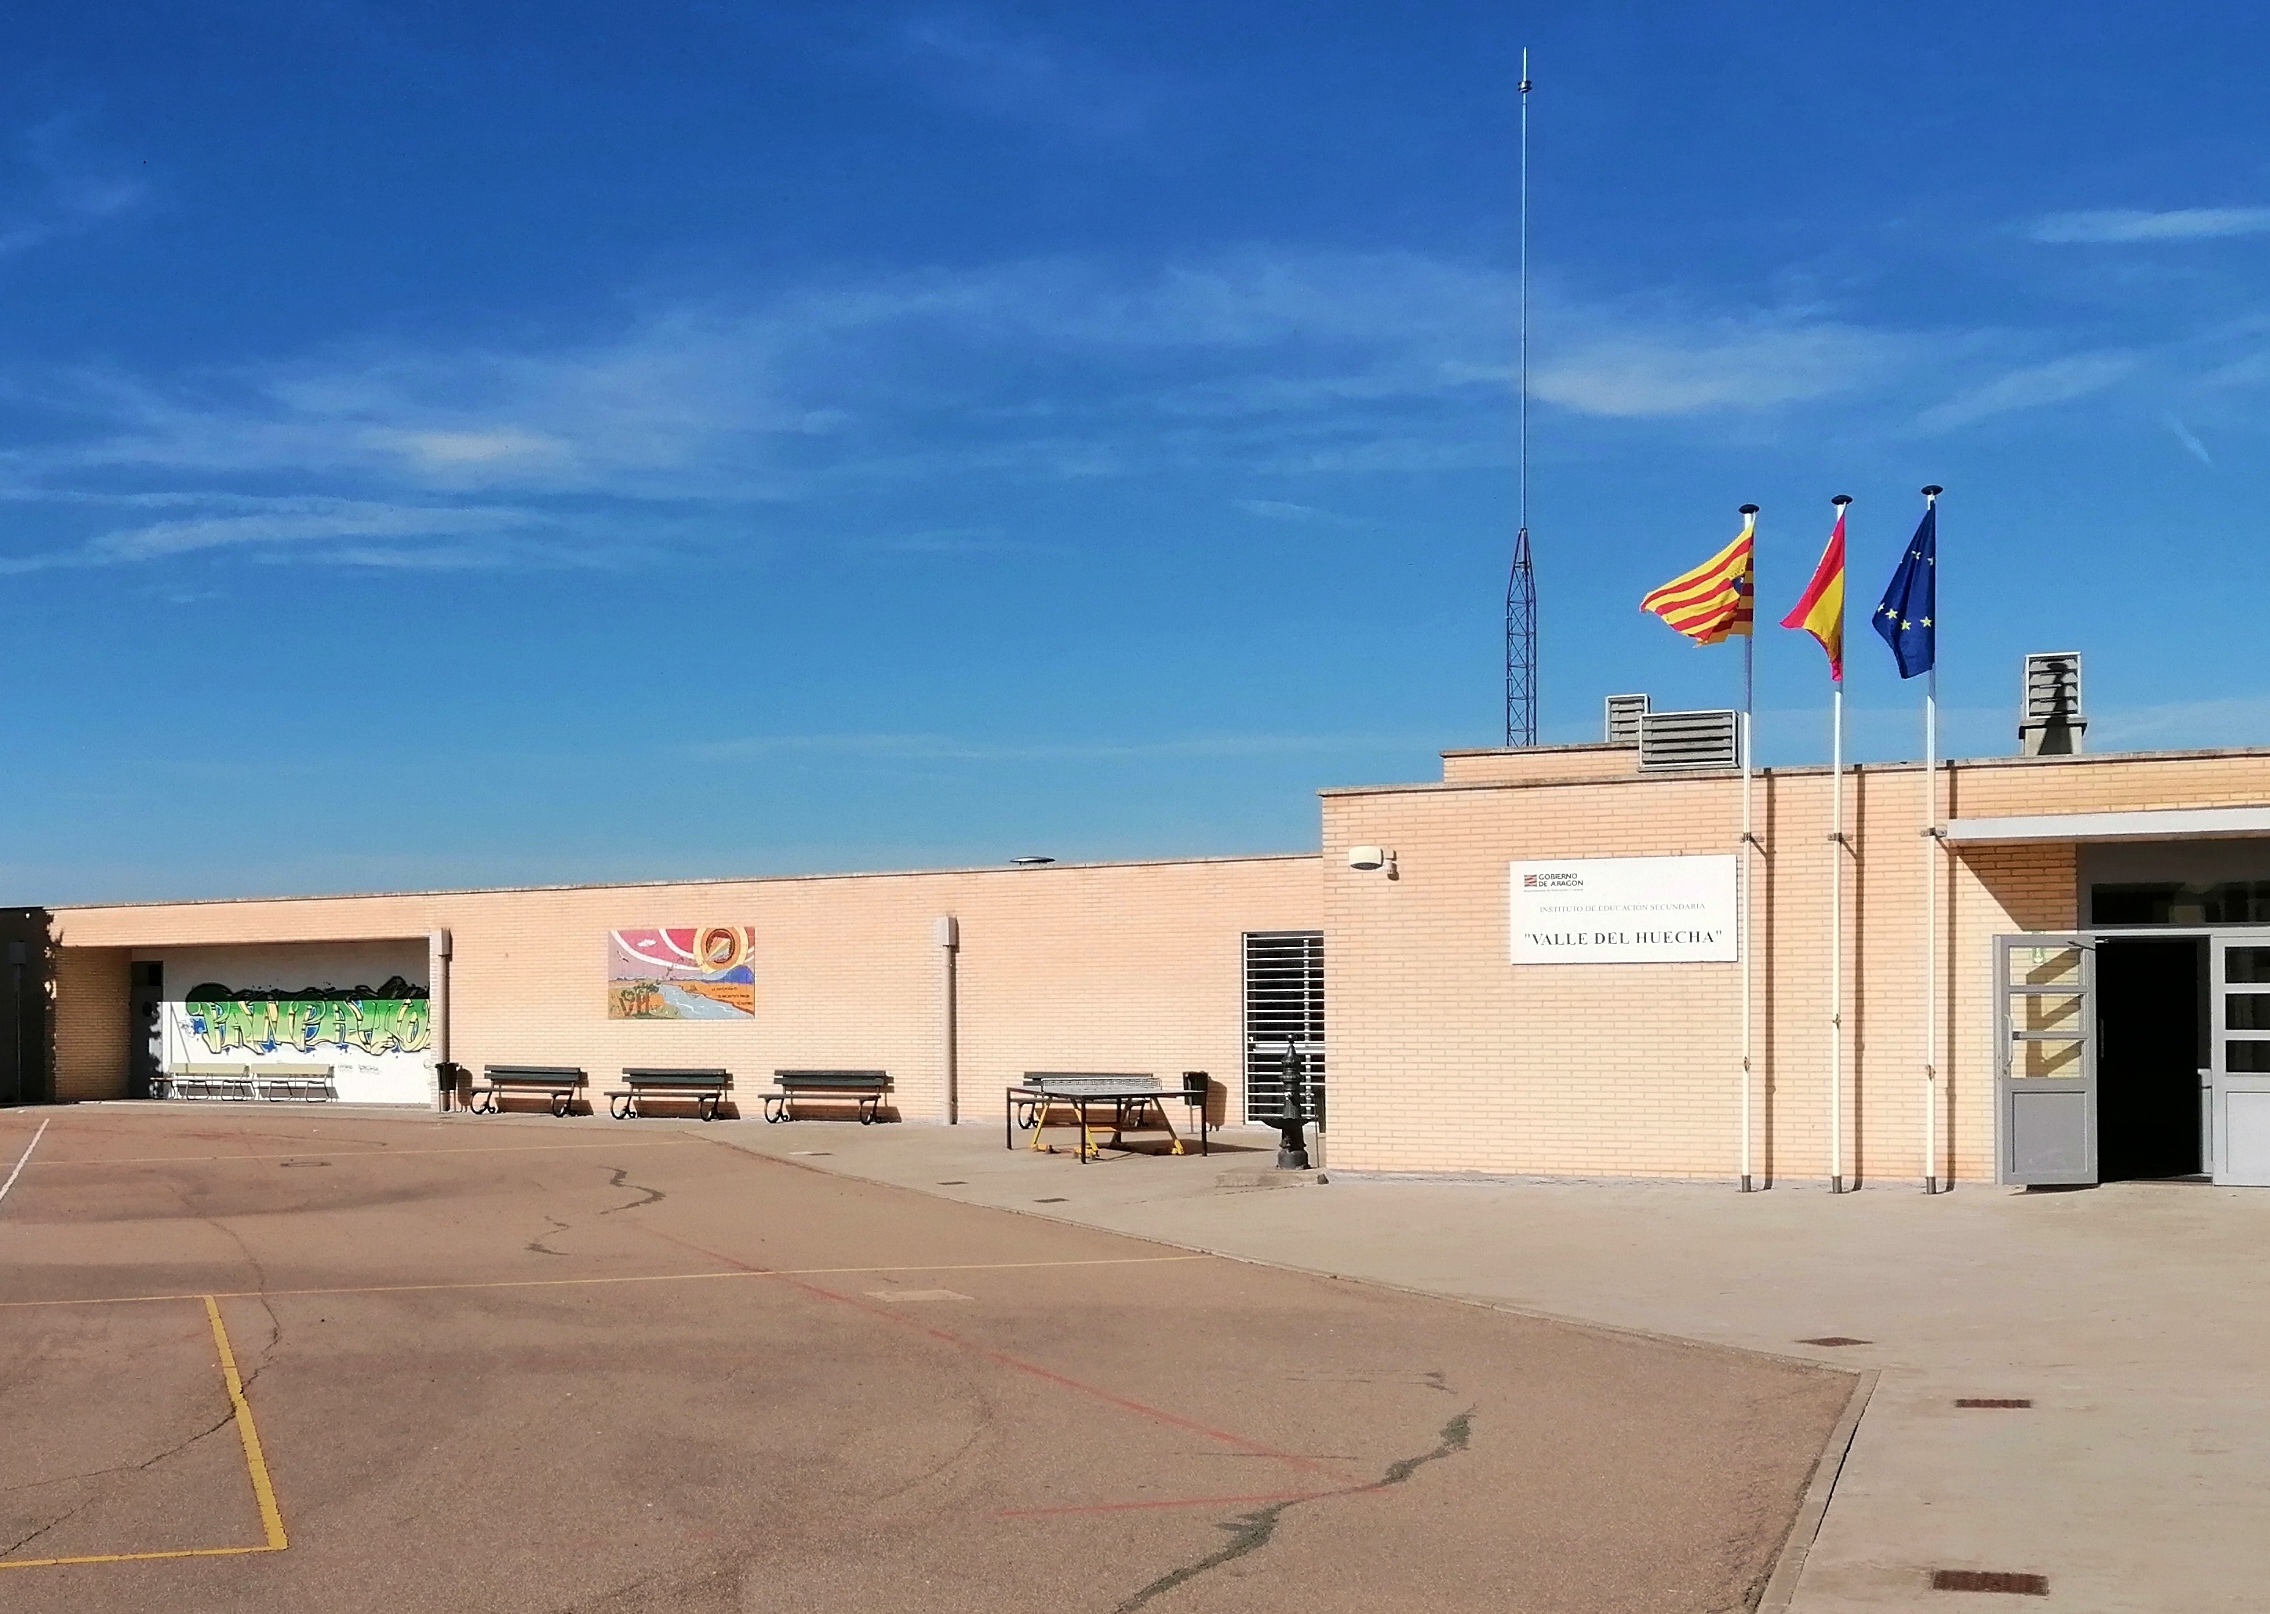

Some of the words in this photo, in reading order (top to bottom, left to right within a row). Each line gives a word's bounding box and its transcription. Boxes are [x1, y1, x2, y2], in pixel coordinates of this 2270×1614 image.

[1539, 905, 1584, 913] INSTITUTO
[1598, 902, 1648, 912] EDUCACIÓN
[1649, 903, 1706, 911] SECUNDARIA
[1524, 933, 1588, 946] "VALLE
[1594, 932, 1630, 945] DEL
[1636, 930, 1722, 944] HUECHA"
